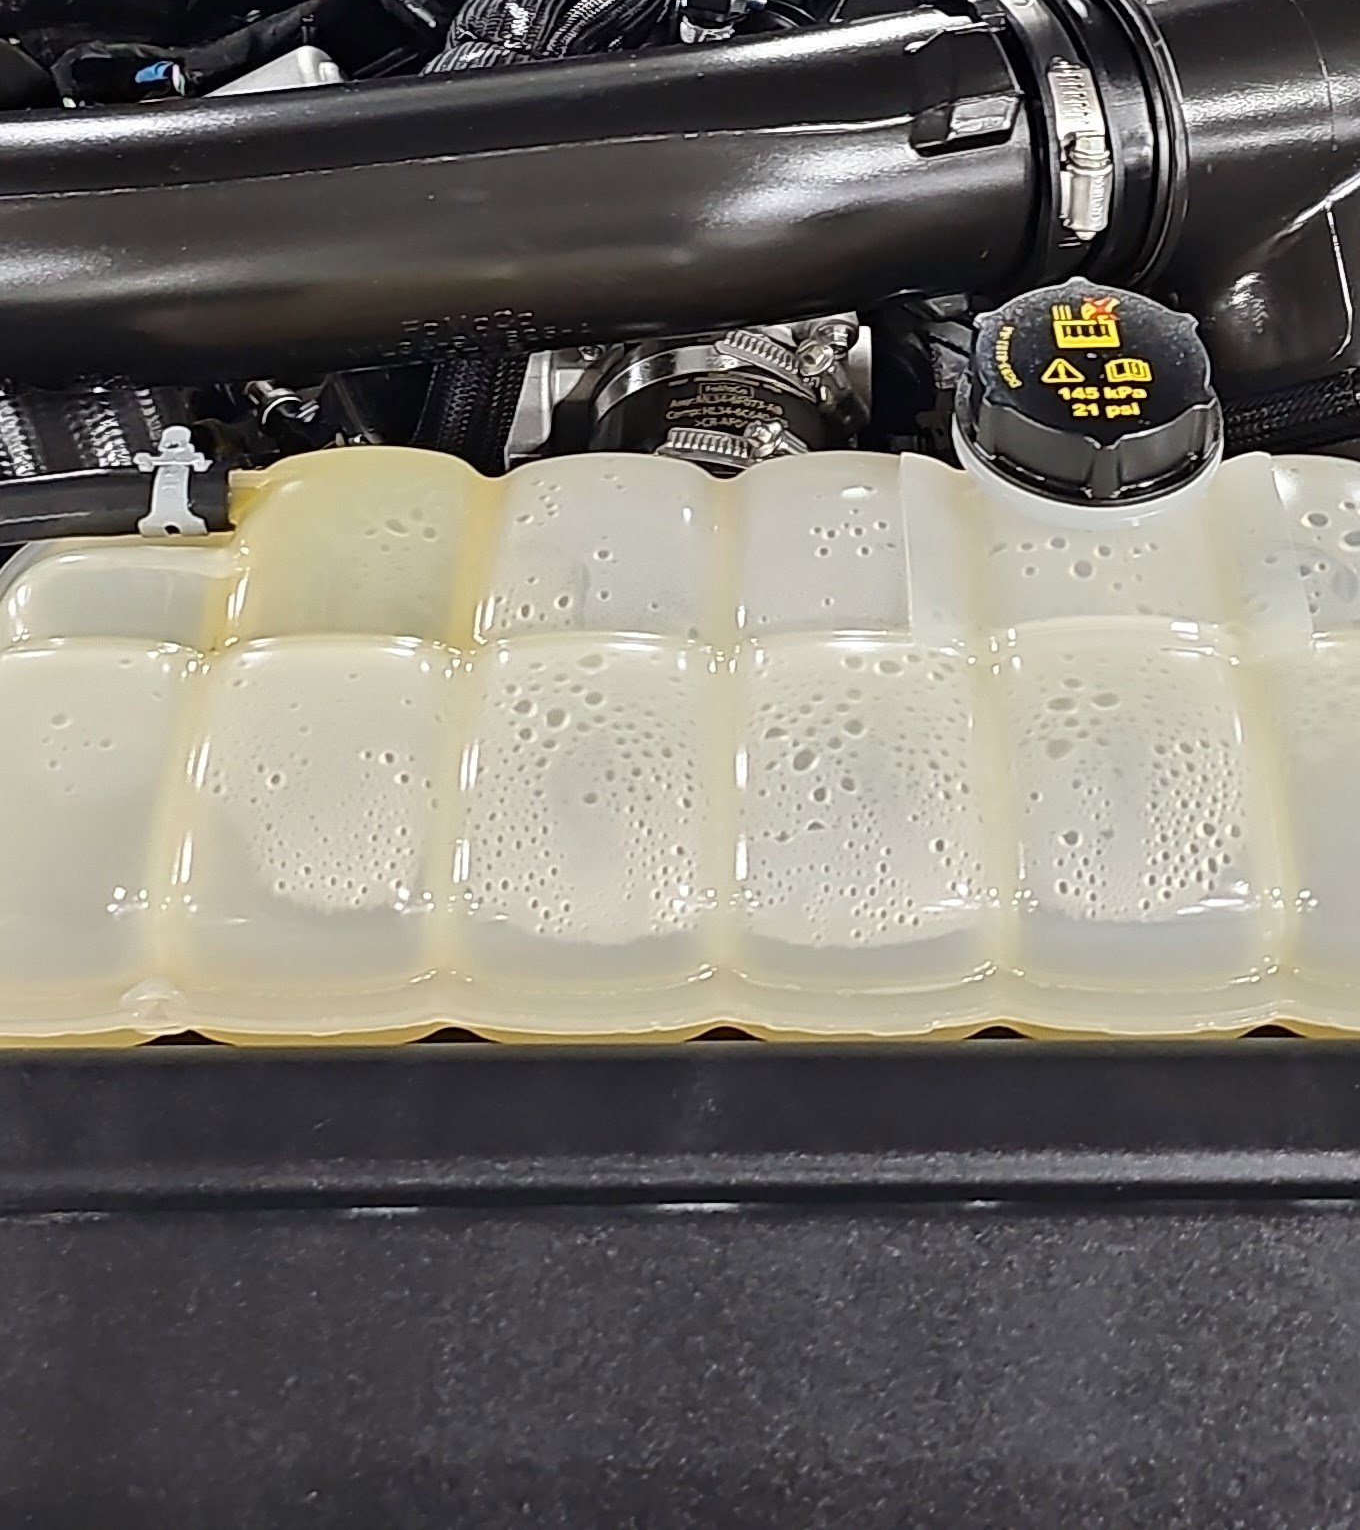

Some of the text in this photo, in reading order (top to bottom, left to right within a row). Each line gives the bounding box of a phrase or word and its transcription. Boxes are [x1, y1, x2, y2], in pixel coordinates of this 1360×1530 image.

[1057, 385, 1148, 401] 145 kPa
[1071, 402, 1100, 417] 21
